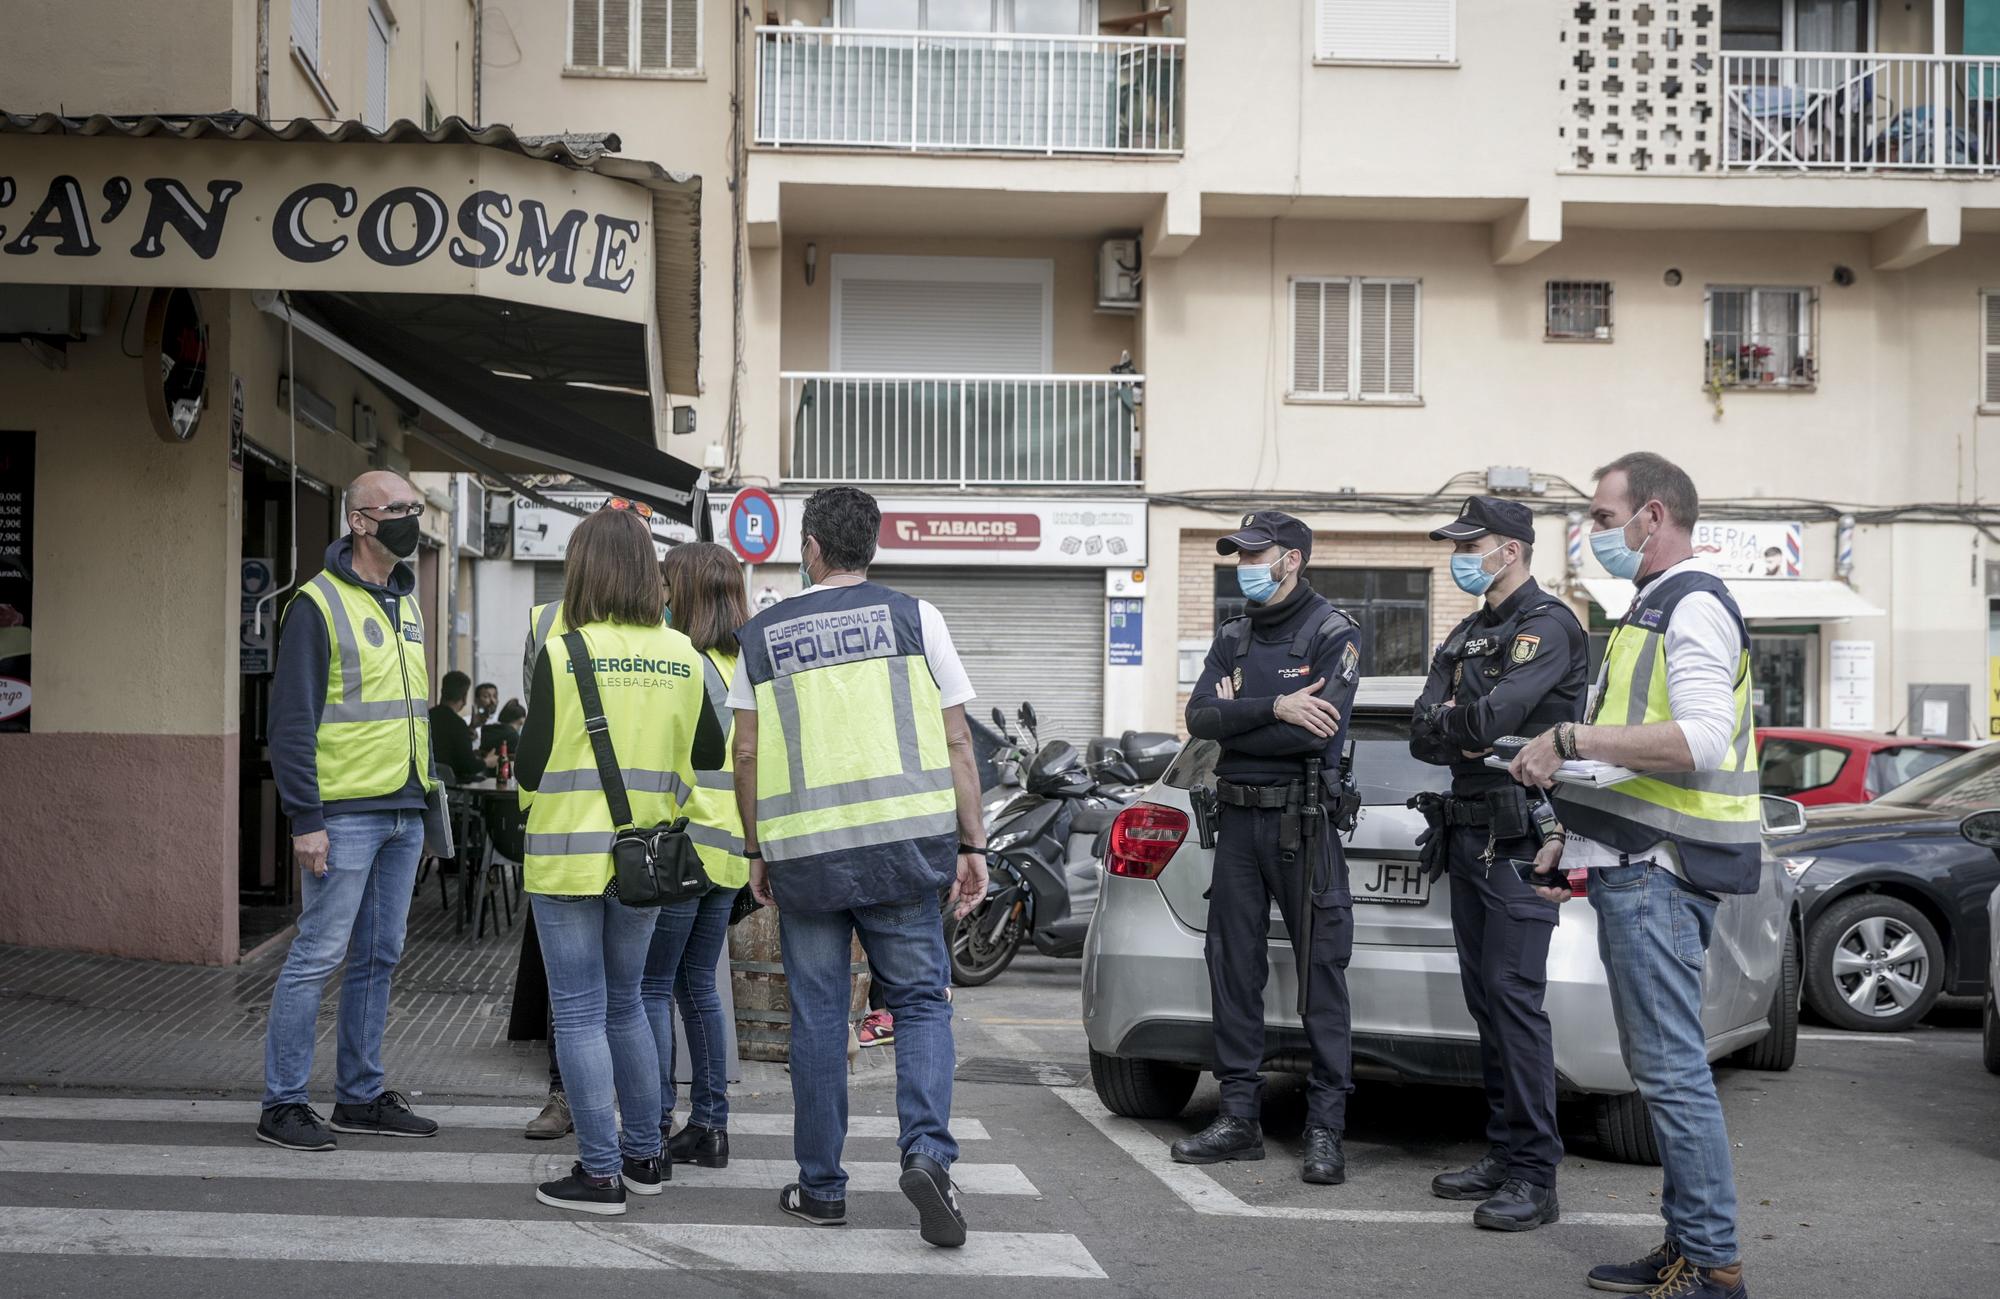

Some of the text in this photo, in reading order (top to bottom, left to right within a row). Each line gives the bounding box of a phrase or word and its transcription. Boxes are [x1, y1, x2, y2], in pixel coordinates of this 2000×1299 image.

[0, 175, 640, 294] A'N COSME
[750, 517, 759, 532] P
[927, 520, 1017, 536] TABACOS
[1695, 526, 1758, 549] BERIA
[769, 609, 887, 642] CUERPO NACIONAL DE
[771, 625, 891, 671] POLICIA
[1464, 638, 1489, 649] POLICIA
[1467, 647, 1482, 655] CNP
[566, 654, 691, 679] EERGÈNCIES
[1364, 864, 1421, 894] JFH
